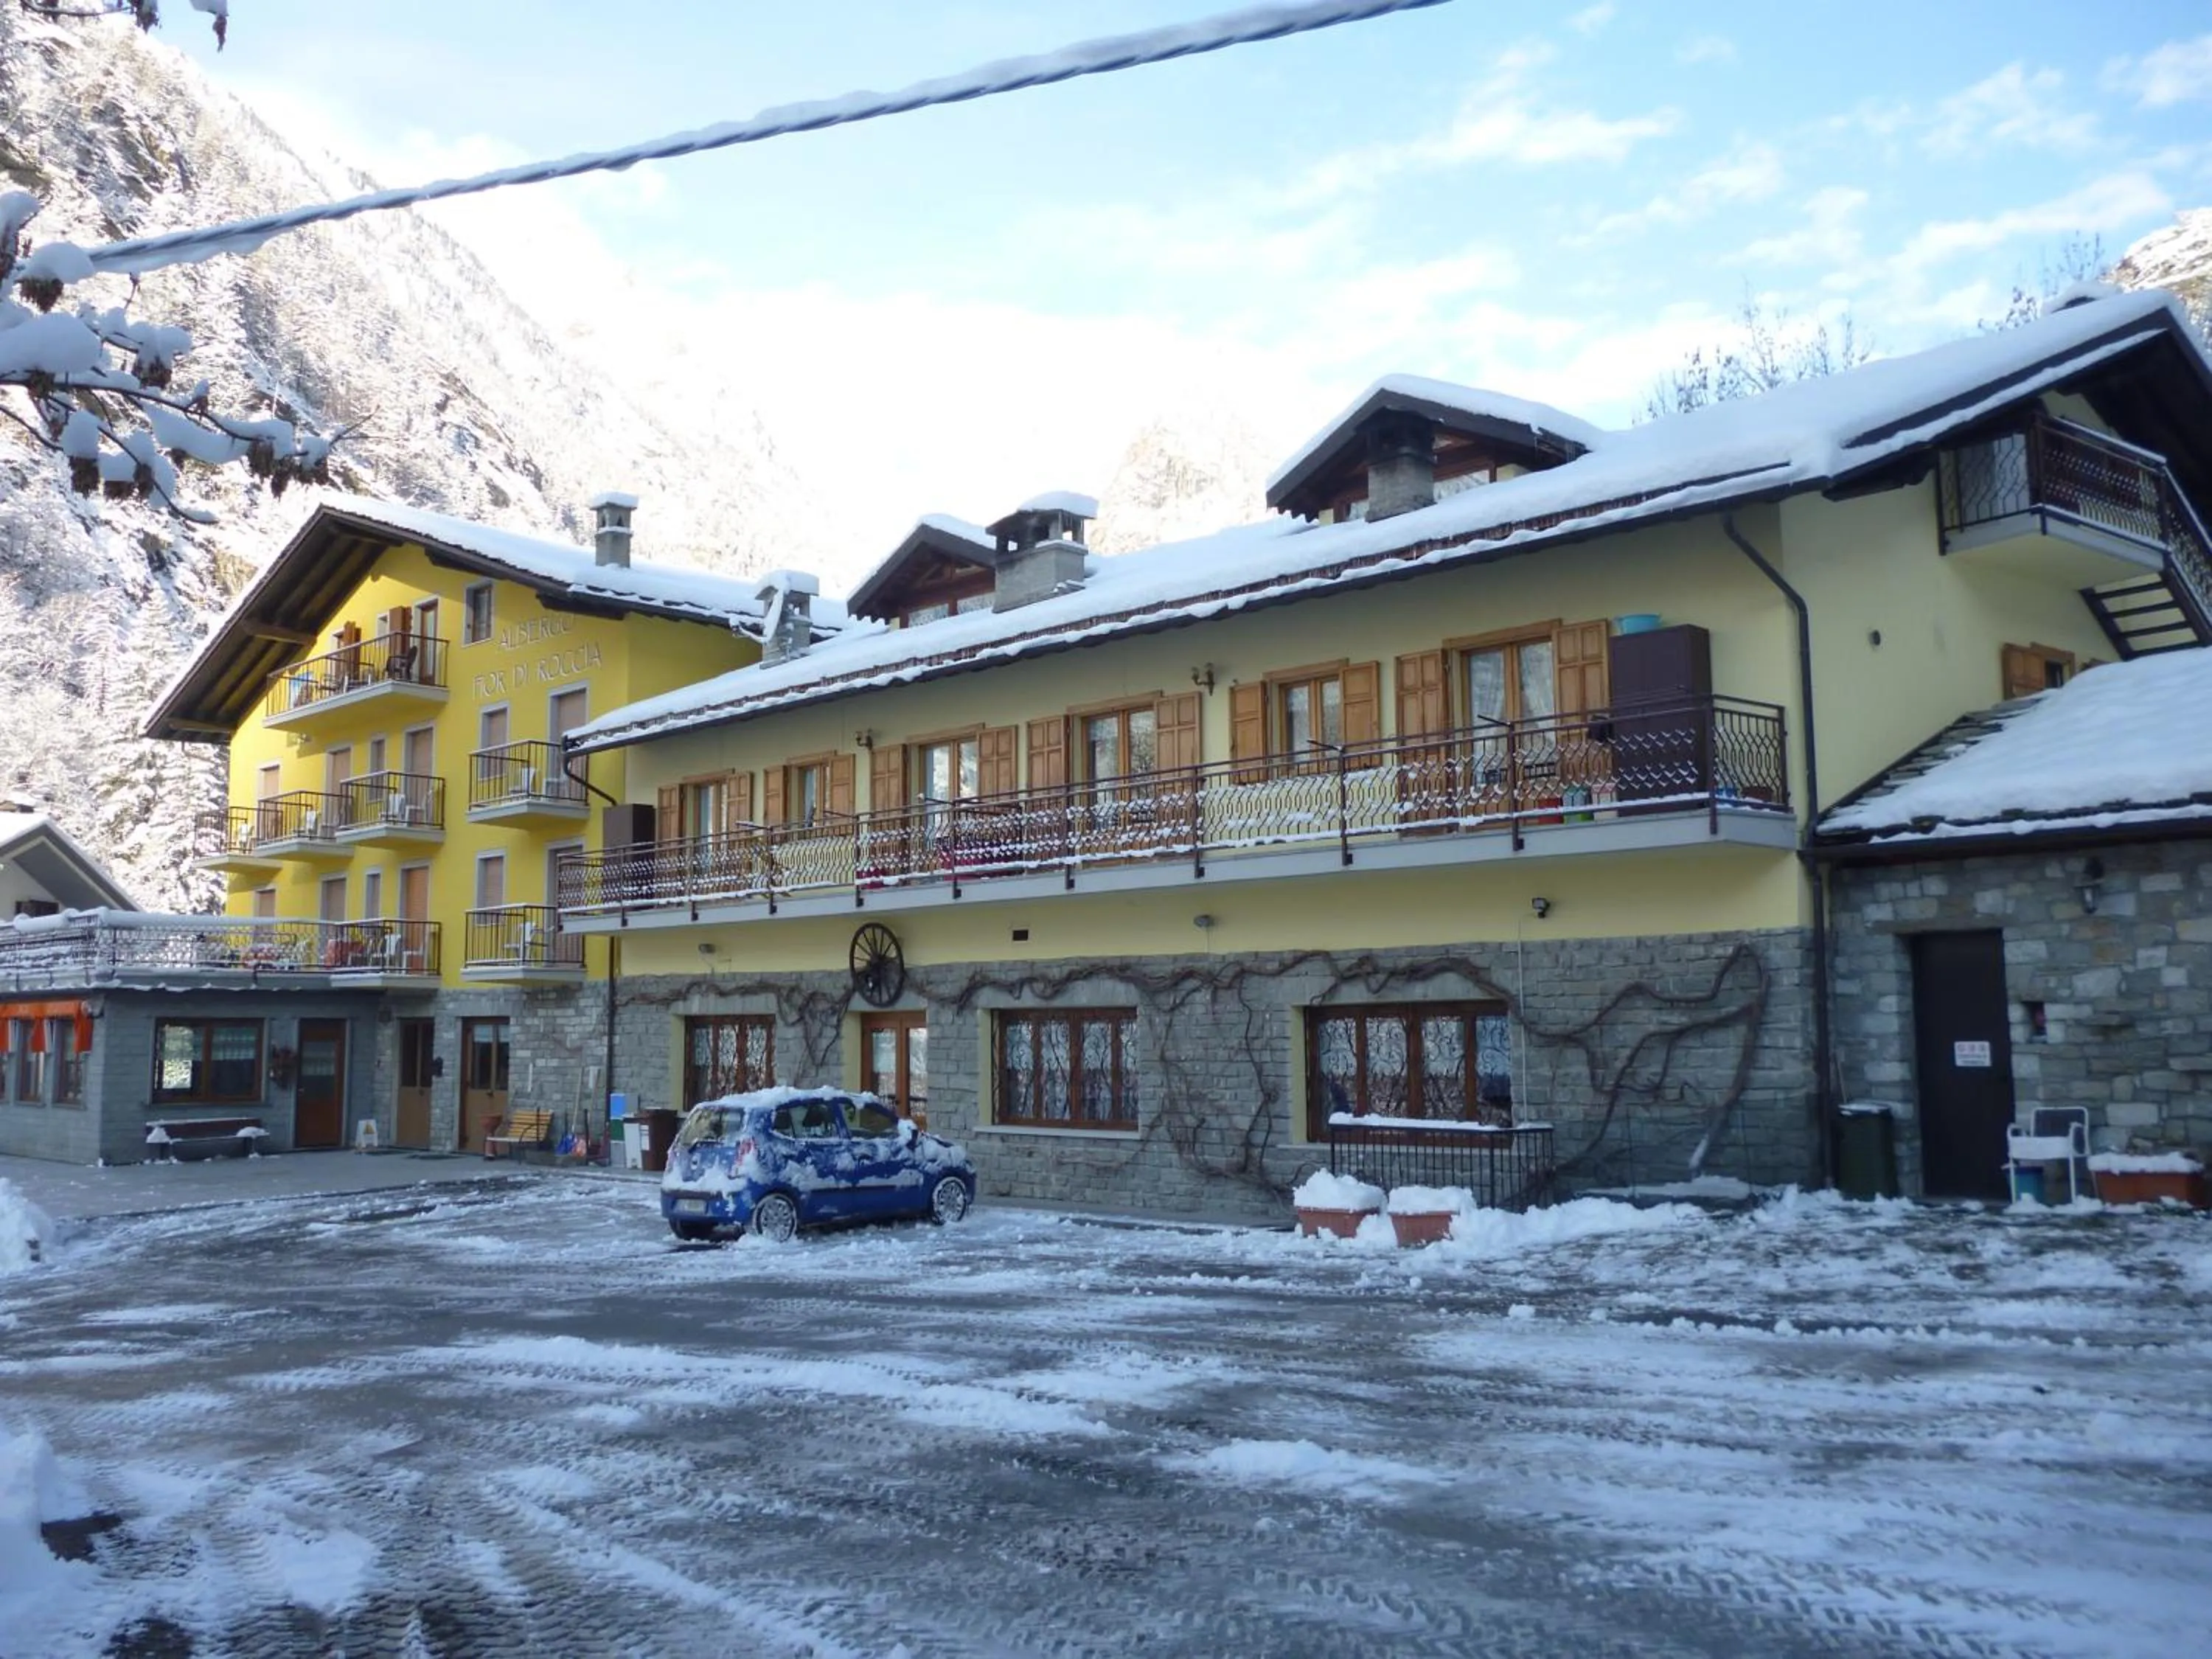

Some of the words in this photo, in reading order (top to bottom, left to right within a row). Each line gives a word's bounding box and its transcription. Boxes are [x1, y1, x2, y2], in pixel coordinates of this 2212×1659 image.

[501, 614, 574, 650] ALBERGO
[512, 661, 529, 687] DI
[538, 641, 602, 682] ROCCIA
